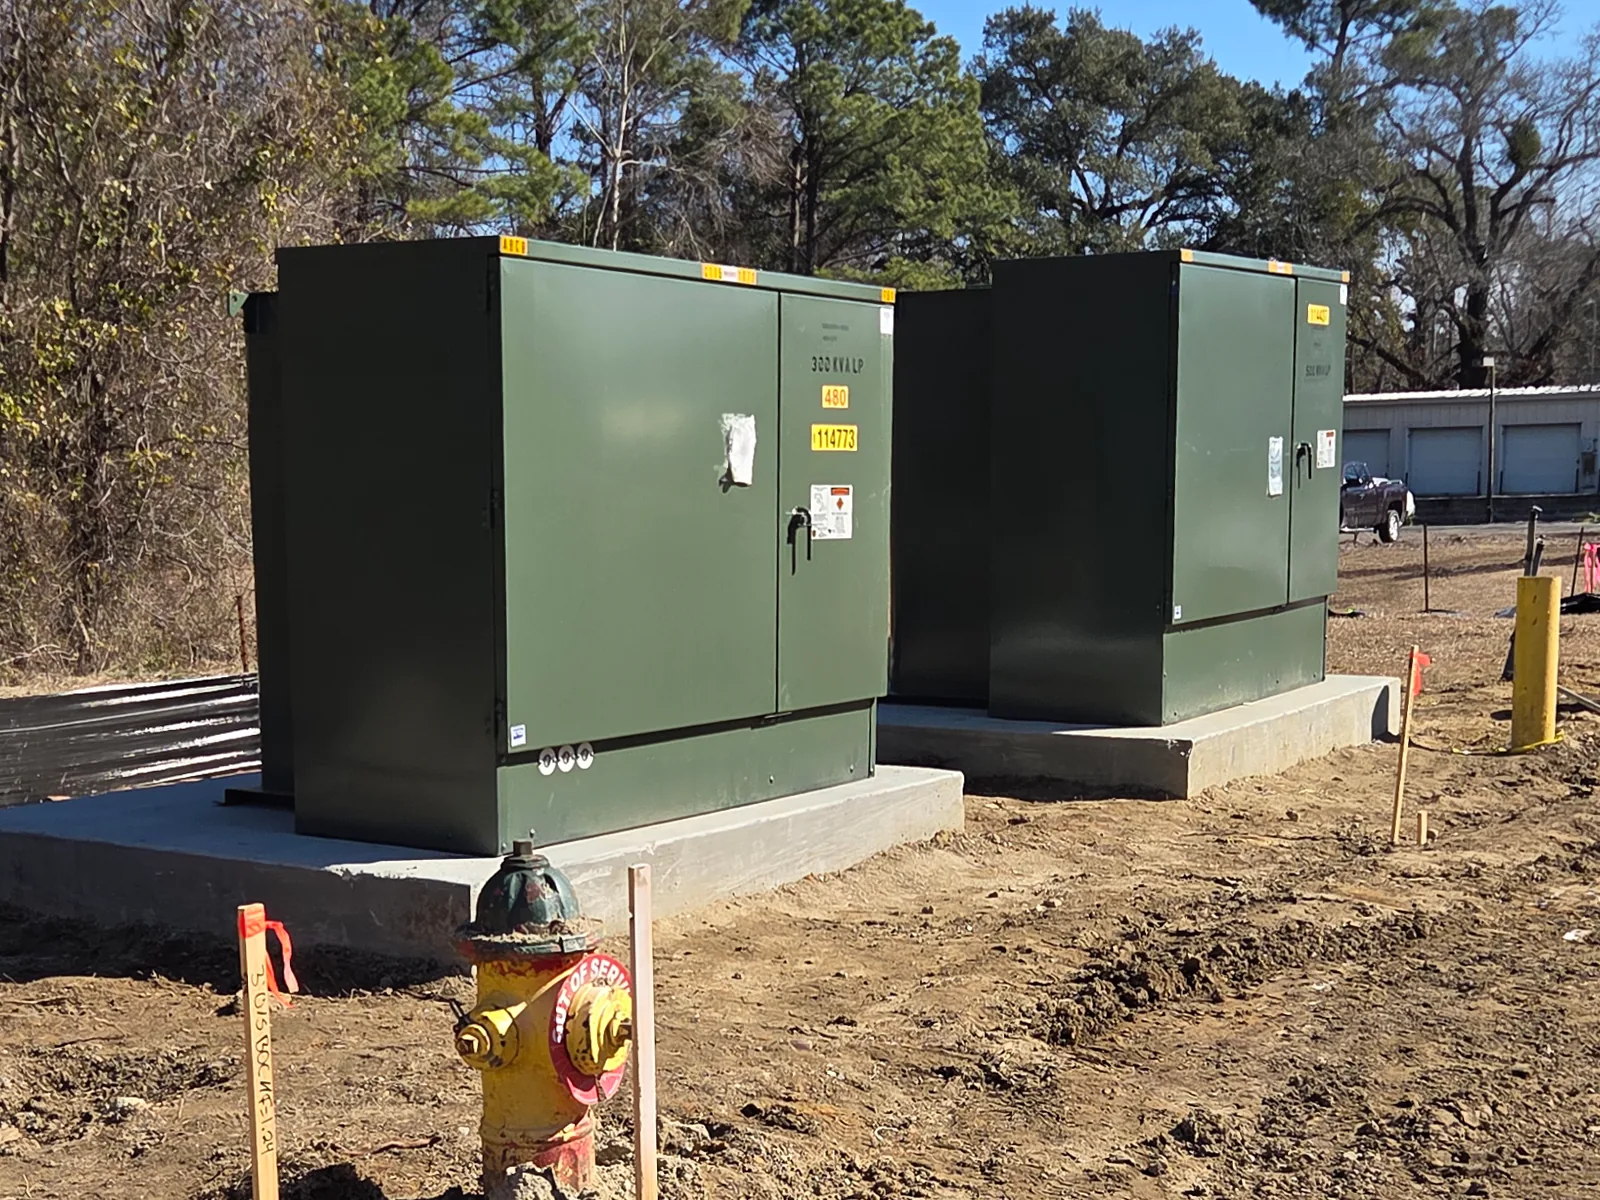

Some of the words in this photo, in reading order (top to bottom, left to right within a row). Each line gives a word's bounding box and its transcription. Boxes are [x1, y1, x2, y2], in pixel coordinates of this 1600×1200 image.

[811, 356, 831, 373] 300
[833, 356, 851, 374] KVA
[853, 358, 864, 374] LP
[824, 389, 847, 406] 480
[817, 428, 855, 449] 114773
[570, 962, 589, 993] OF
